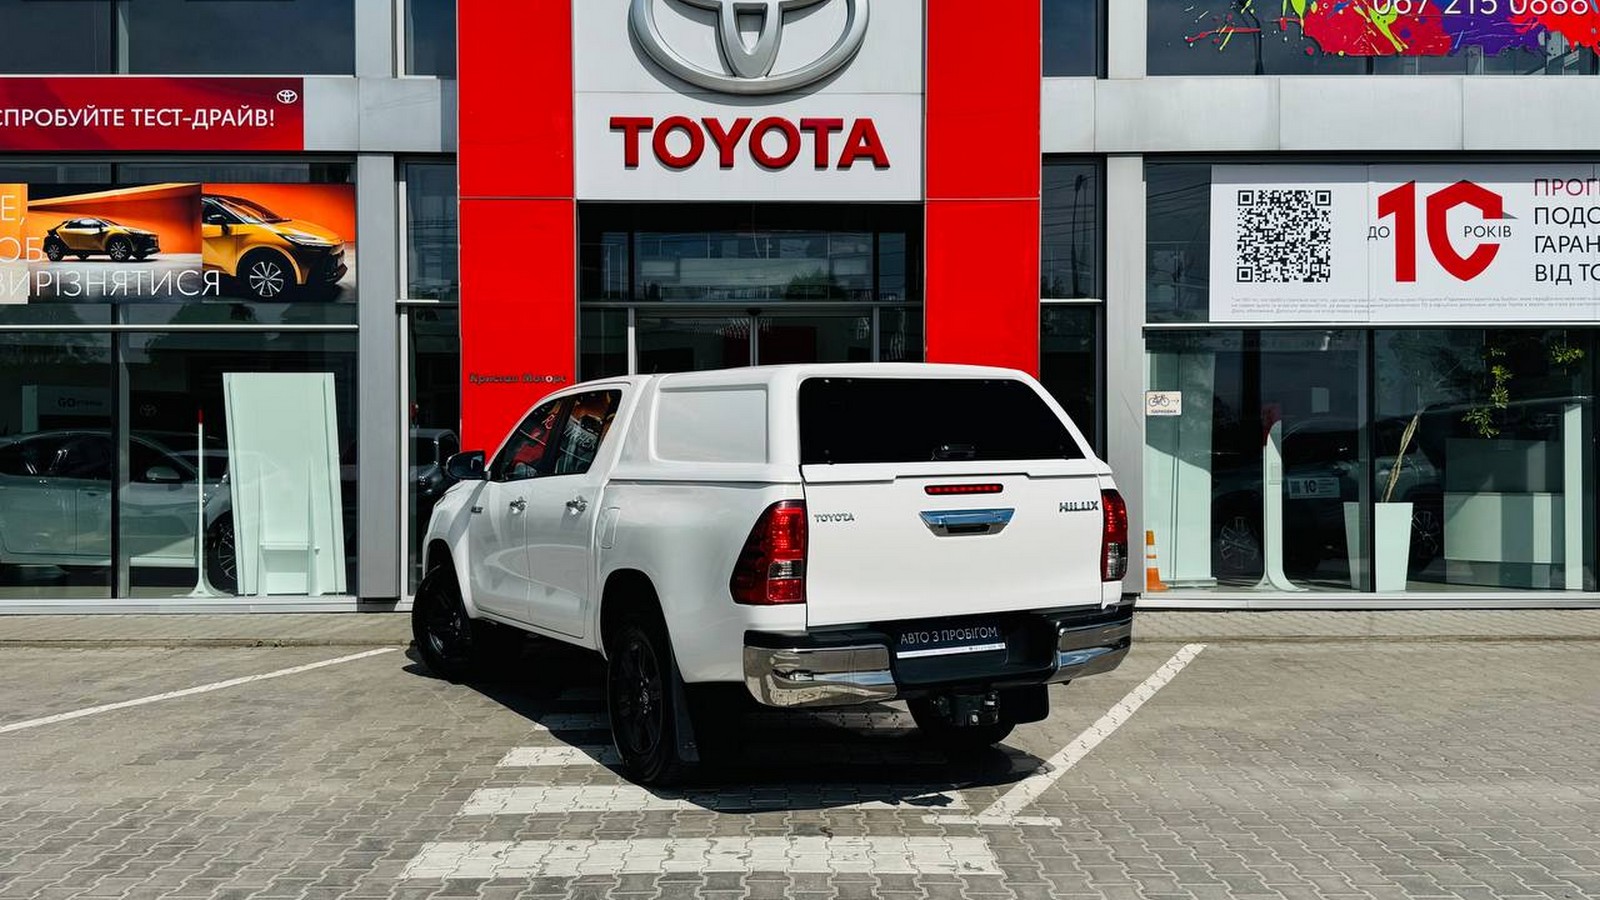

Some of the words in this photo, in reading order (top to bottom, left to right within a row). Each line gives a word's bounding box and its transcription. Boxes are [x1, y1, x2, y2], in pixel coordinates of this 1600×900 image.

[1444, 0, 1497, 15] 215
[0, 105, 125, 127] ПРОБУЙТЕ
[131, 105, 276, 130] ТЕСТ-ДРАЙВ!
[610, 116, 890, 170] TOYOTA
[1535, 178, 1600, 196] ПРОГ
[1367, 226, 1390, 241] ДО
[1378, 180, 1503, 282] 10
[1464, 226, 1512, 238] РОКІВ
[1535, 235, 1600, 253] ГАРАН
[1535, 264, 1572, 285] ВІД
[1059, 500, 1099, 512] HILUX
[813, 512, 855, 523] TOYOTA
[901, 631, 930, 645] АВТО
[941, 626, 998, 641] ПРОБІГОМ
